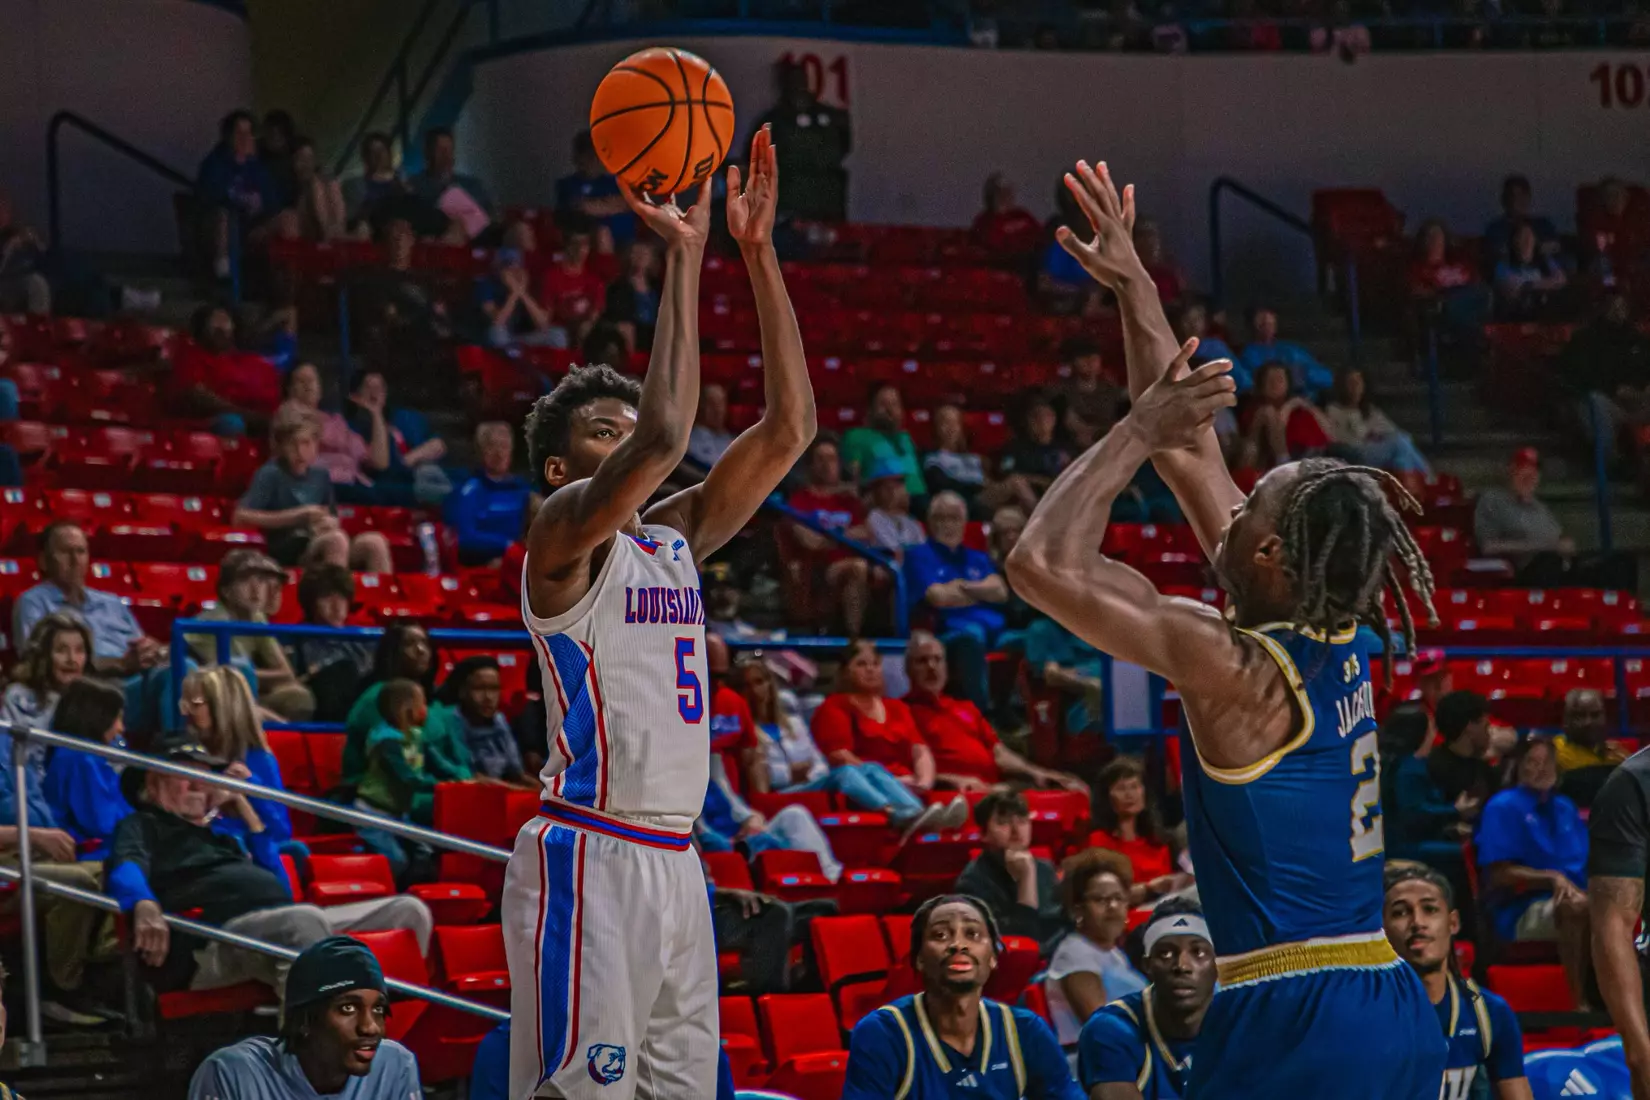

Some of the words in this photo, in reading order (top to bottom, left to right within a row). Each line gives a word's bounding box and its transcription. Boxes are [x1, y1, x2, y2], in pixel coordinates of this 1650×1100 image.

[780, 52, 849, 108] 01
[1589, 61, 1650, 109] 10
[674, 637, 705, 724] 5
[1350, 730, 1385, 862] 2
